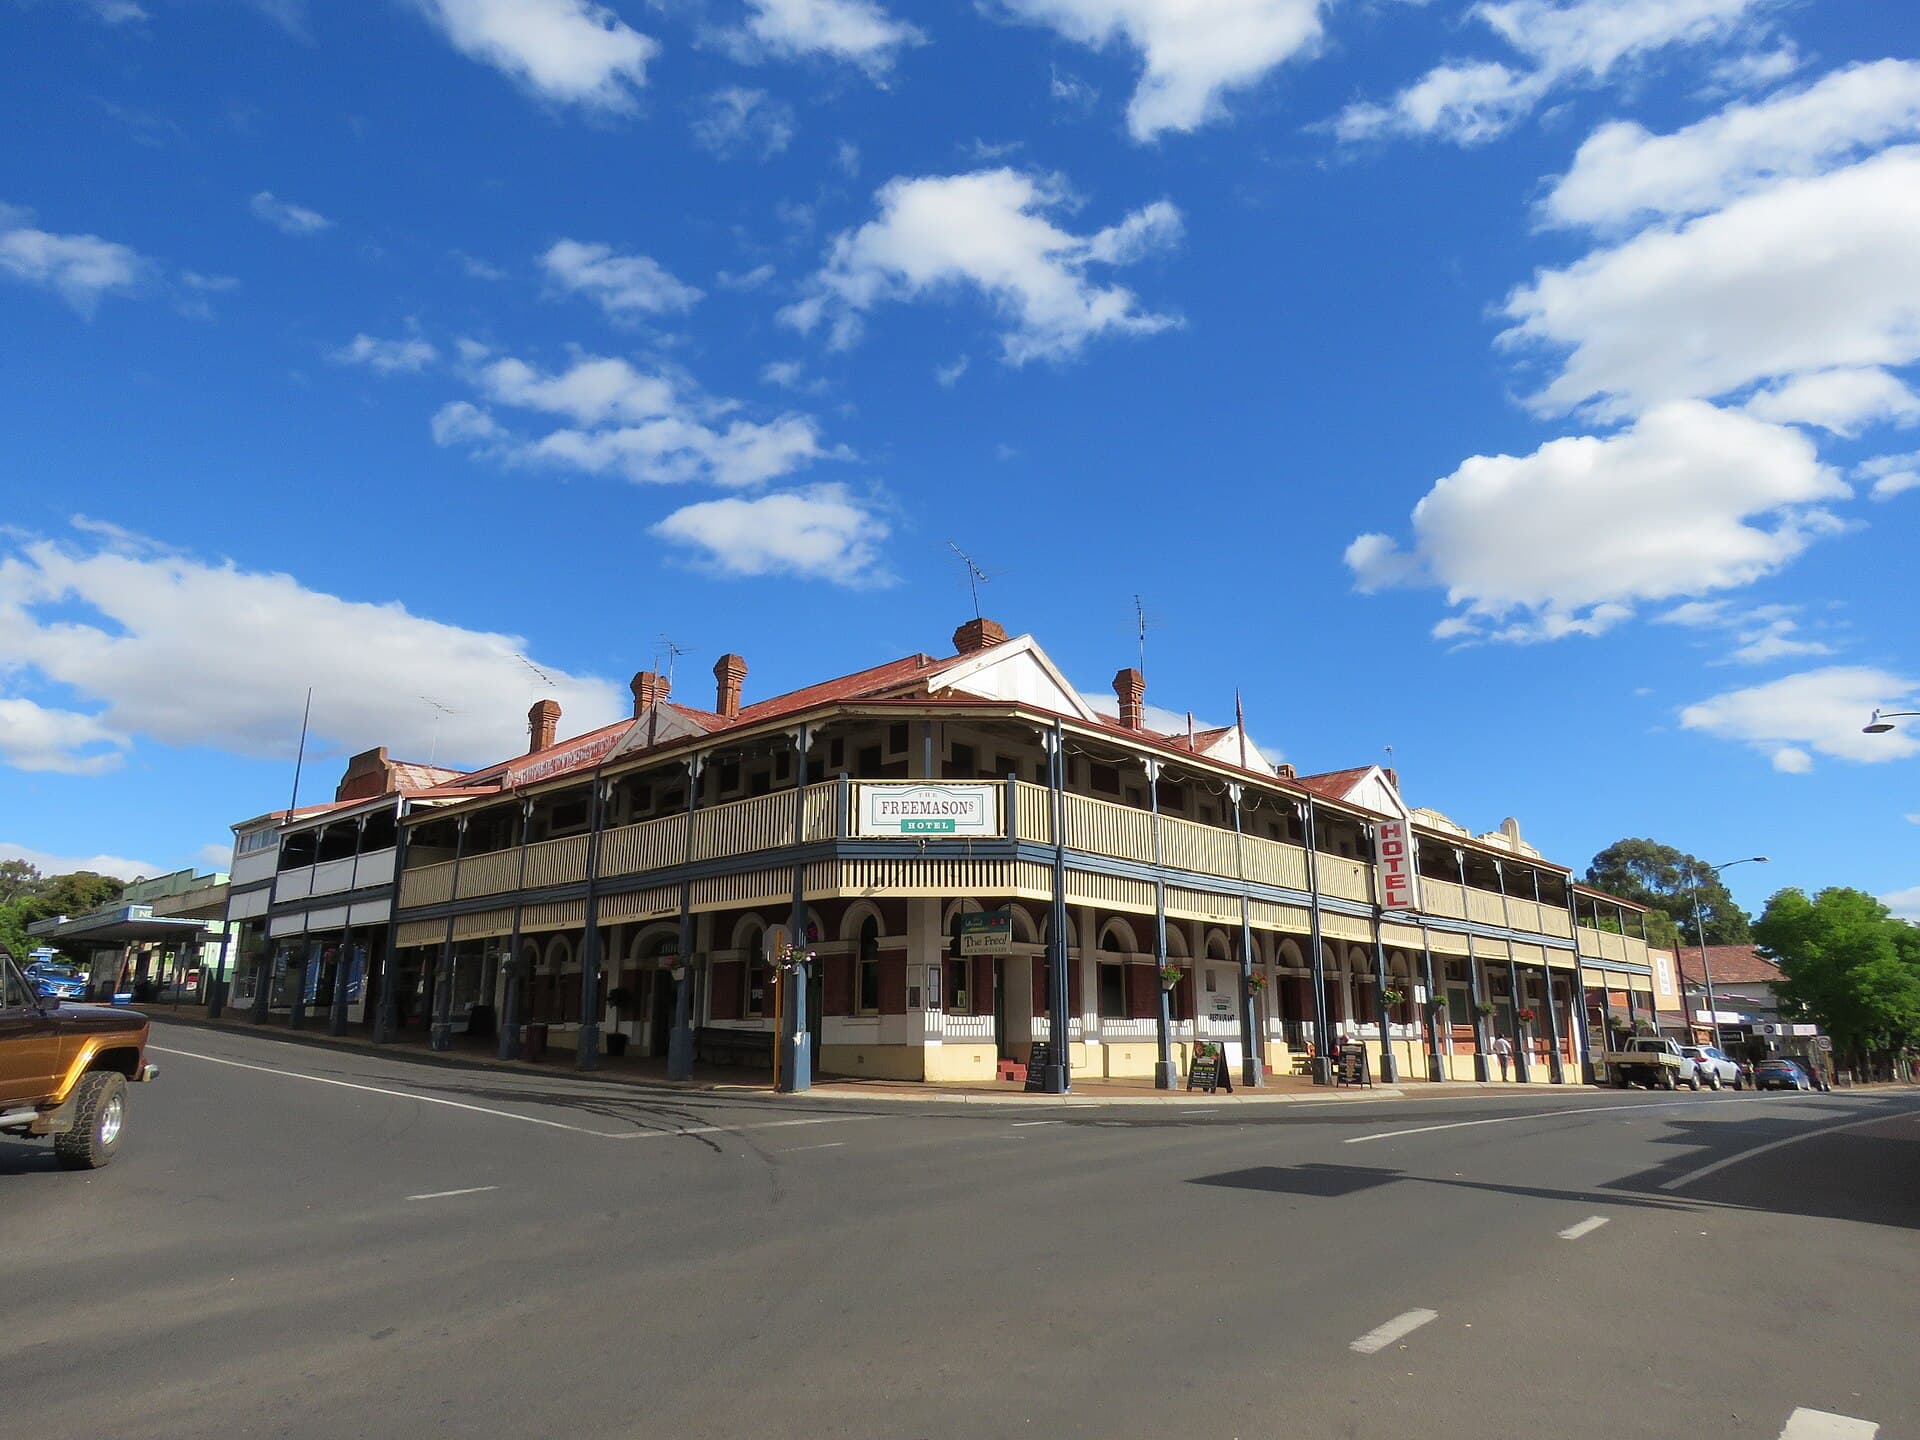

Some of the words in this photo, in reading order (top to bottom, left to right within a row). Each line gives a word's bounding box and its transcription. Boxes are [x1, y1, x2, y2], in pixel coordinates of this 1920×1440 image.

[881, 801, 974, 815] FREEMASONS
[907, 822, 949, 830] HOTEL
[1380, 823, 1408, 906] HOTEL
[964, 935, 982, 948] The
[984, 933, 1008, 946] Freo!
